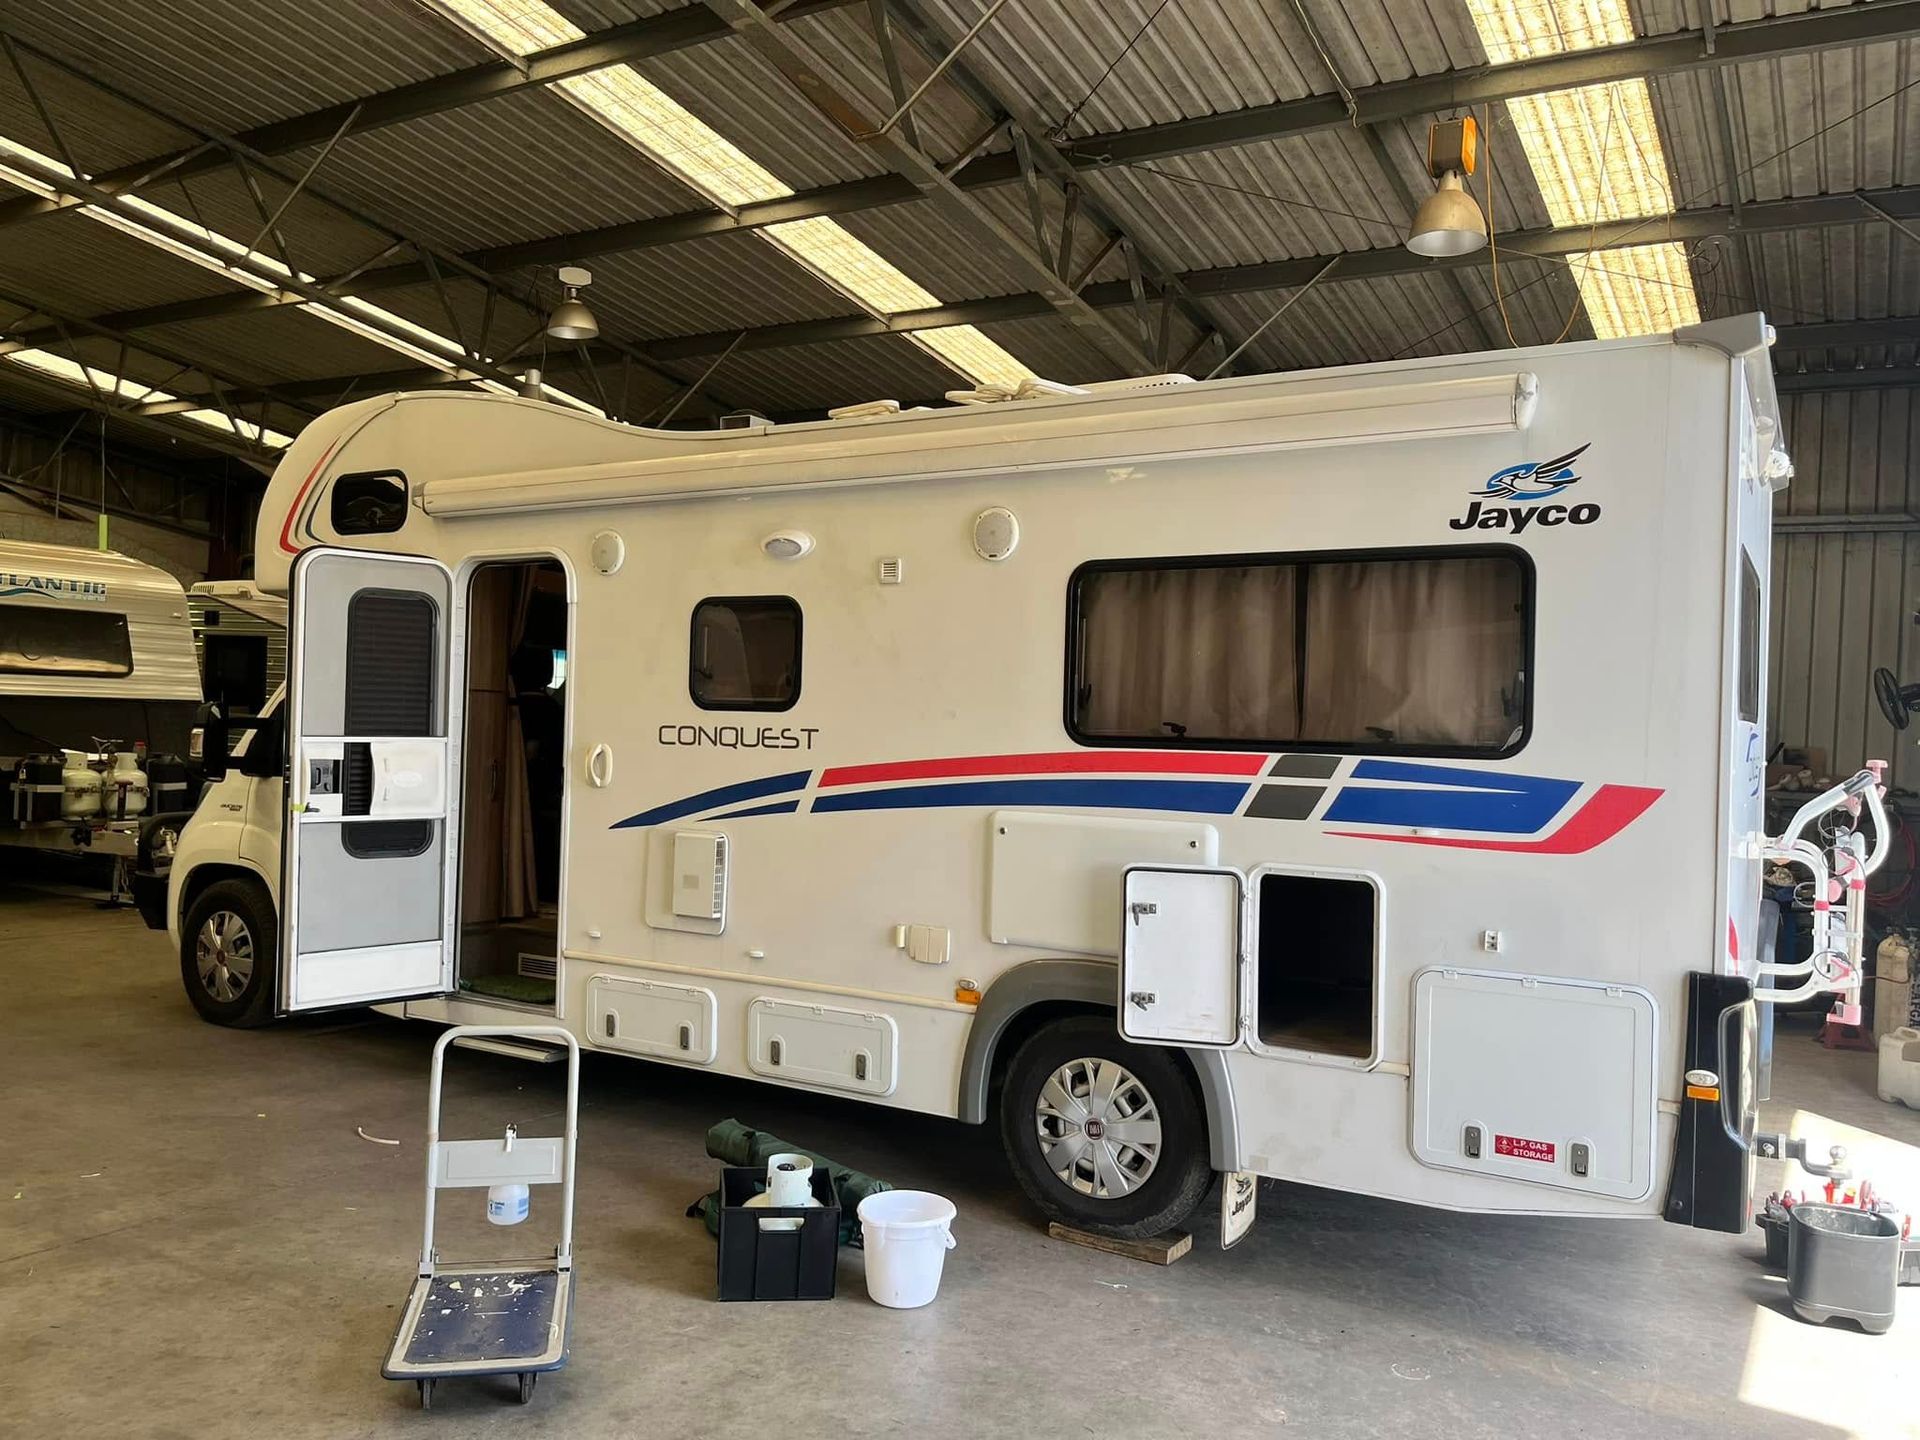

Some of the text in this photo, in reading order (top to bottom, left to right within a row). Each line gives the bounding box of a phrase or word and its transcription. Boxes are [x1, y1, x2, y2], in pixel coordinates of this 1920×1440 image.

[1449, 501, 1601, 535] Jayco
[658, 725, 820, 750] CONQUEST
[1513, 1148, 1554, 1161] STORAGE
[1529, 1142, 1548, 1151] GAS
